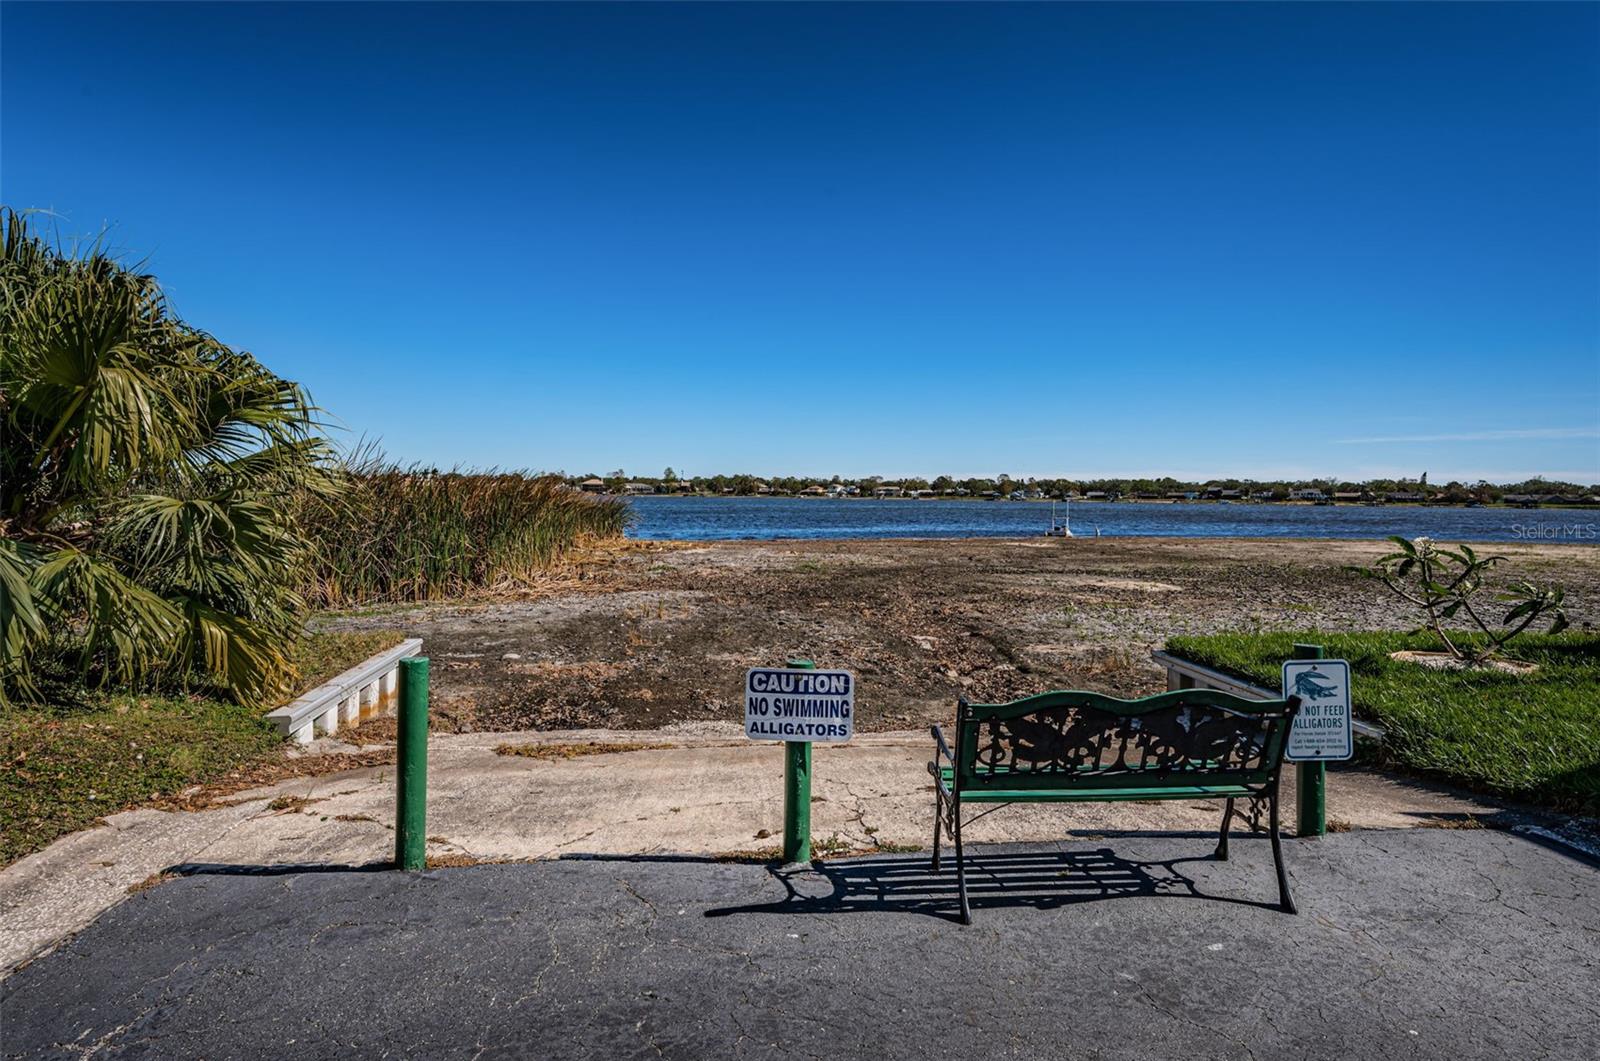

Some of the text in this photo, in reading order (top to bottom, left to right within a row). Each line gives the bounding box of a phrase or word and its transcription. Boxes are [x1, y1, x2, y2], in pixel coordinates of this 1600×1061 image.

[752, 673, 846, 693] CAUTION
[748, 697, 850, 718] NO SWIMMING
[1304, 705, 1321, 717] NOT
[1324, 704, 1345, 716] FEED
[749, 721, 847, 736] ALLIGATORS
[1292, 717, 1343, 729] ALLIGATORS
